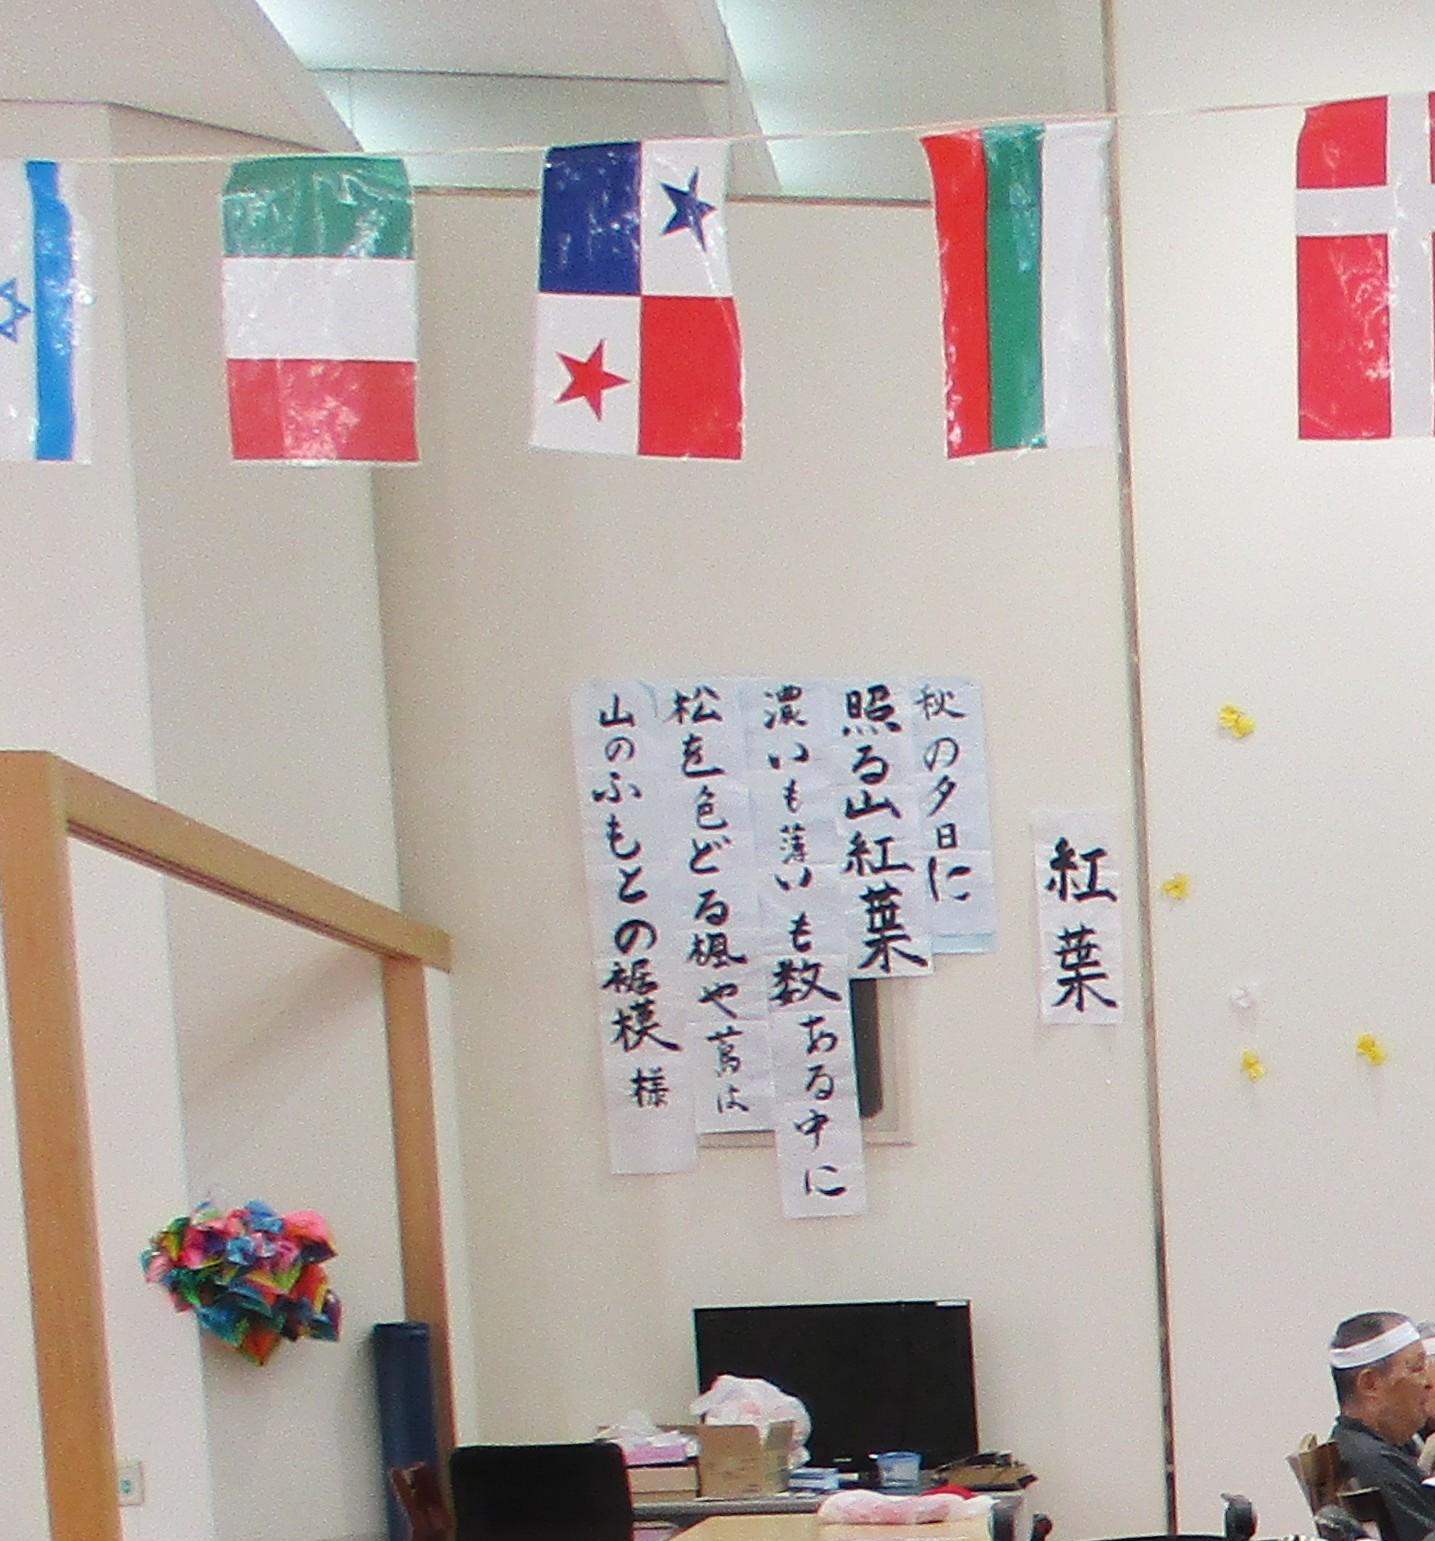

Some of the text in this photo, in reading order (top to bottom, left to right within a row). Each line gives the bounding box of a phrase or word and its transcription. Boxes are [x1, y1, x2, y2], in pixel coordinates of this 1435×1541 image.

[592, 694, 681, 1108] 山のふもとの裾模様
[841, 684, 927, 973] 照る山紅葉
[916, 684, 972, 902] 秋の夕日に
[1045, 837, 1118, 1012] 紅葉
[763, 686, 848, 1198] 濃いも薄いも数ある中に
